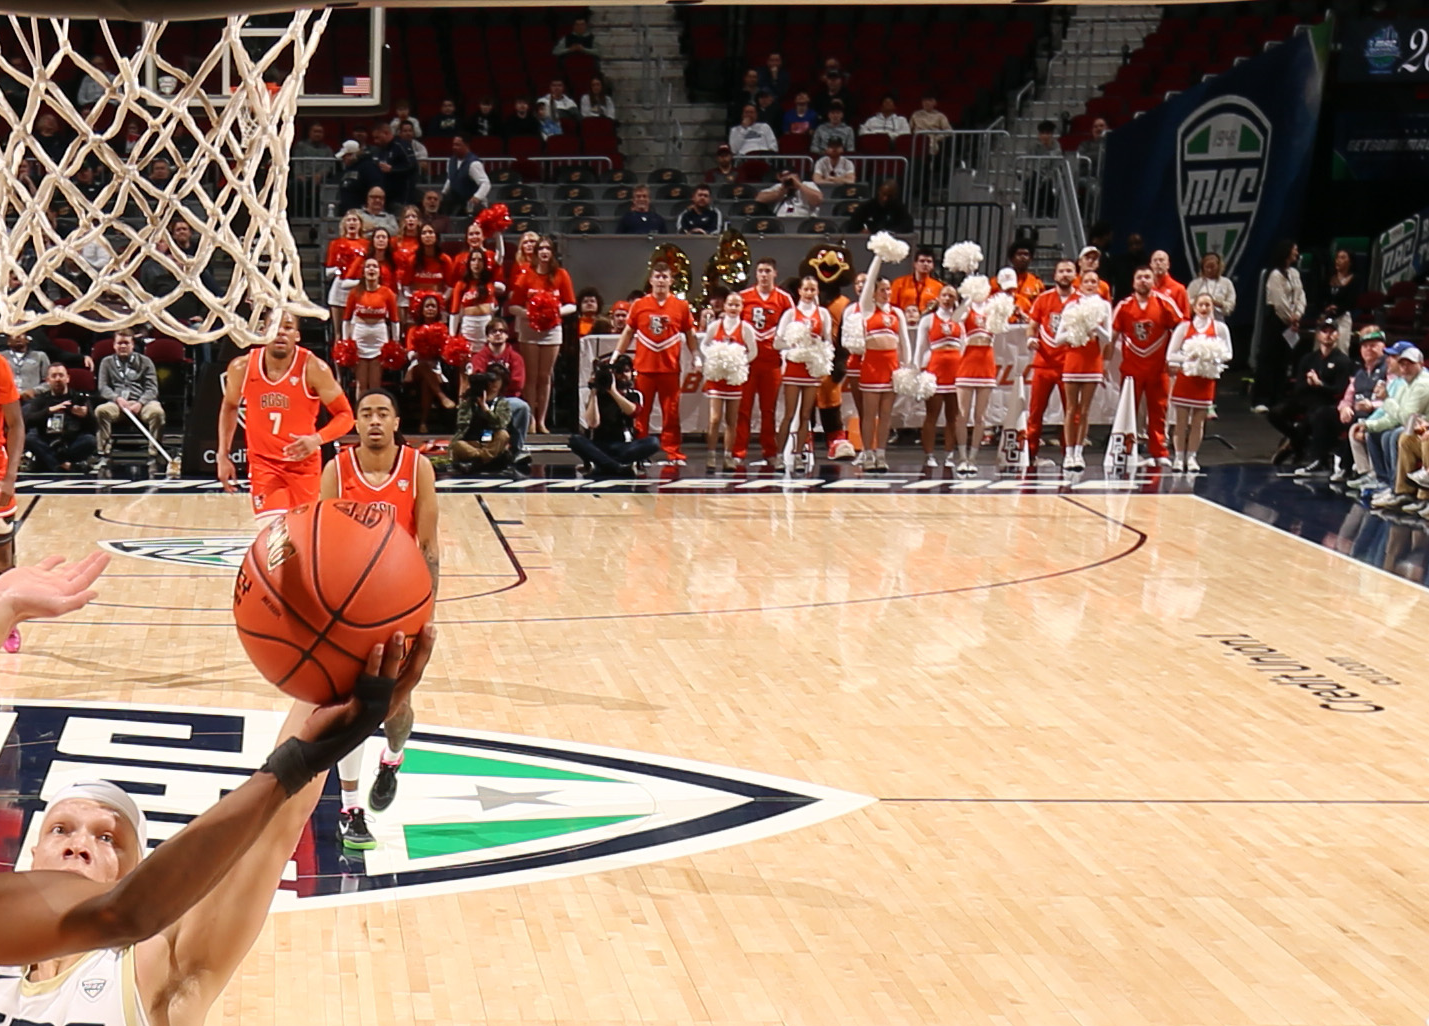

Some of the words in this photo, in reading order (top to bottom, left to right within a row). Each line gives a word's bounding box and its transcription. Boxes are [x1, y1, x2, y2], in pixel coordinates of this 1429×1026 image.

[1181, 167, 1260, 217] MAC
[259, 391, 291, 411] BGSU
[268, 412, 282, 435] 7
[1219, 639, 1311, 672] Union
[1269, 673, 1385, 713] Credit
